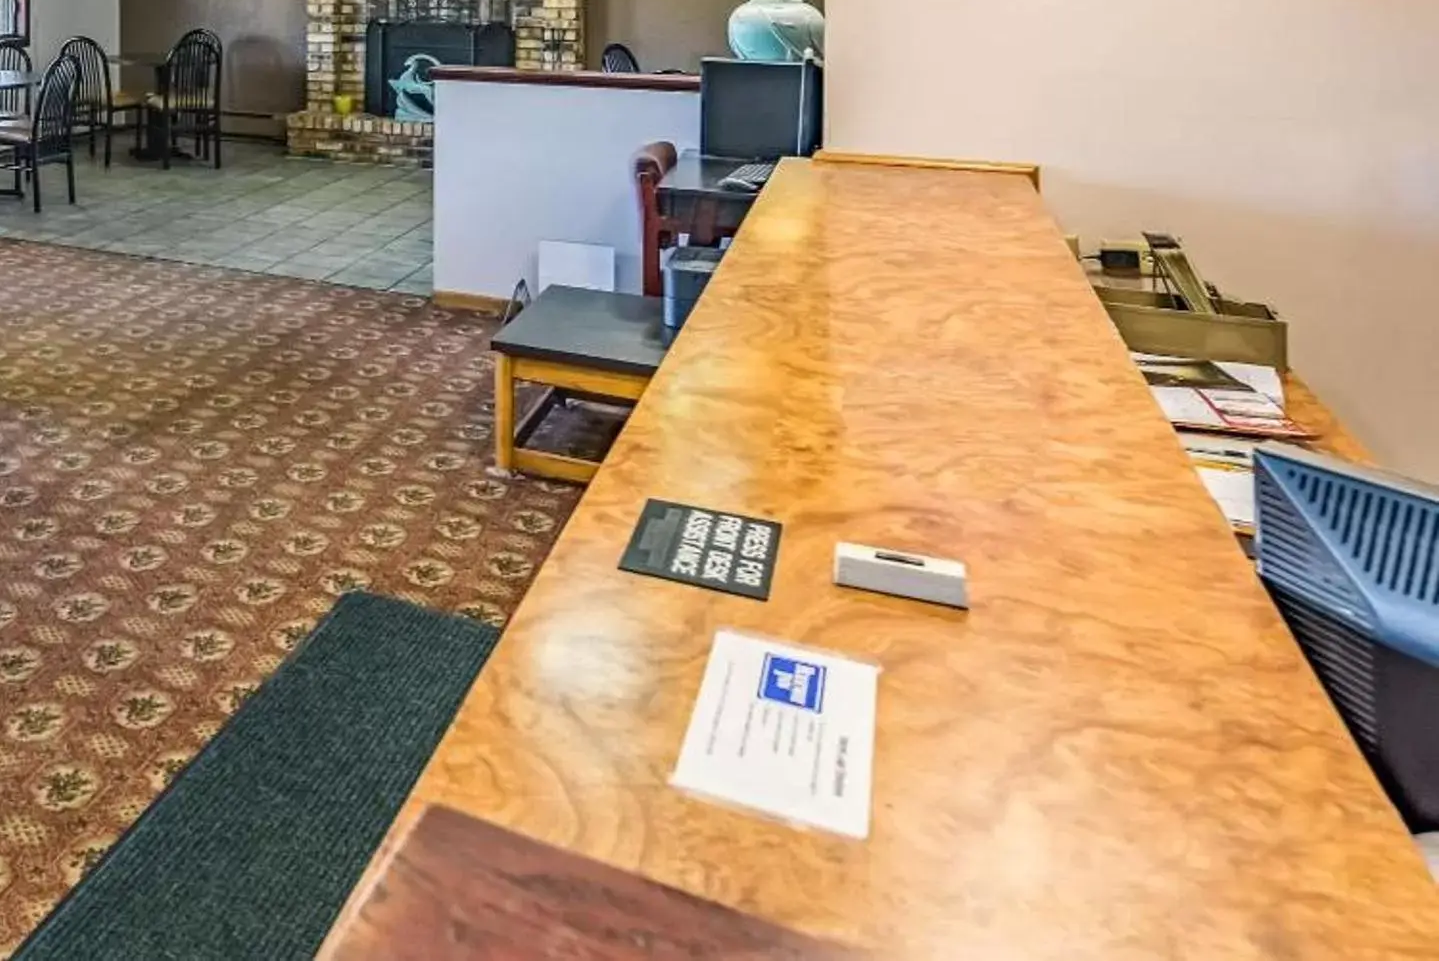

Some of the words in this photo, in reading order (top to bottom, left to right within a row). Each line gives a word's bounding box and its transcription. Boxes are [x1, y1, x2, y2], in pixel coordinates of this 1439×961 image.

[670, 510, 714, 577] ASSISTANCE
[712, 514, 743, 552] FRONT
[740, 522, 772, 560] PRESS
[701, 549, 734, 583] DESK
[734, 559, 764, 587] FOR
